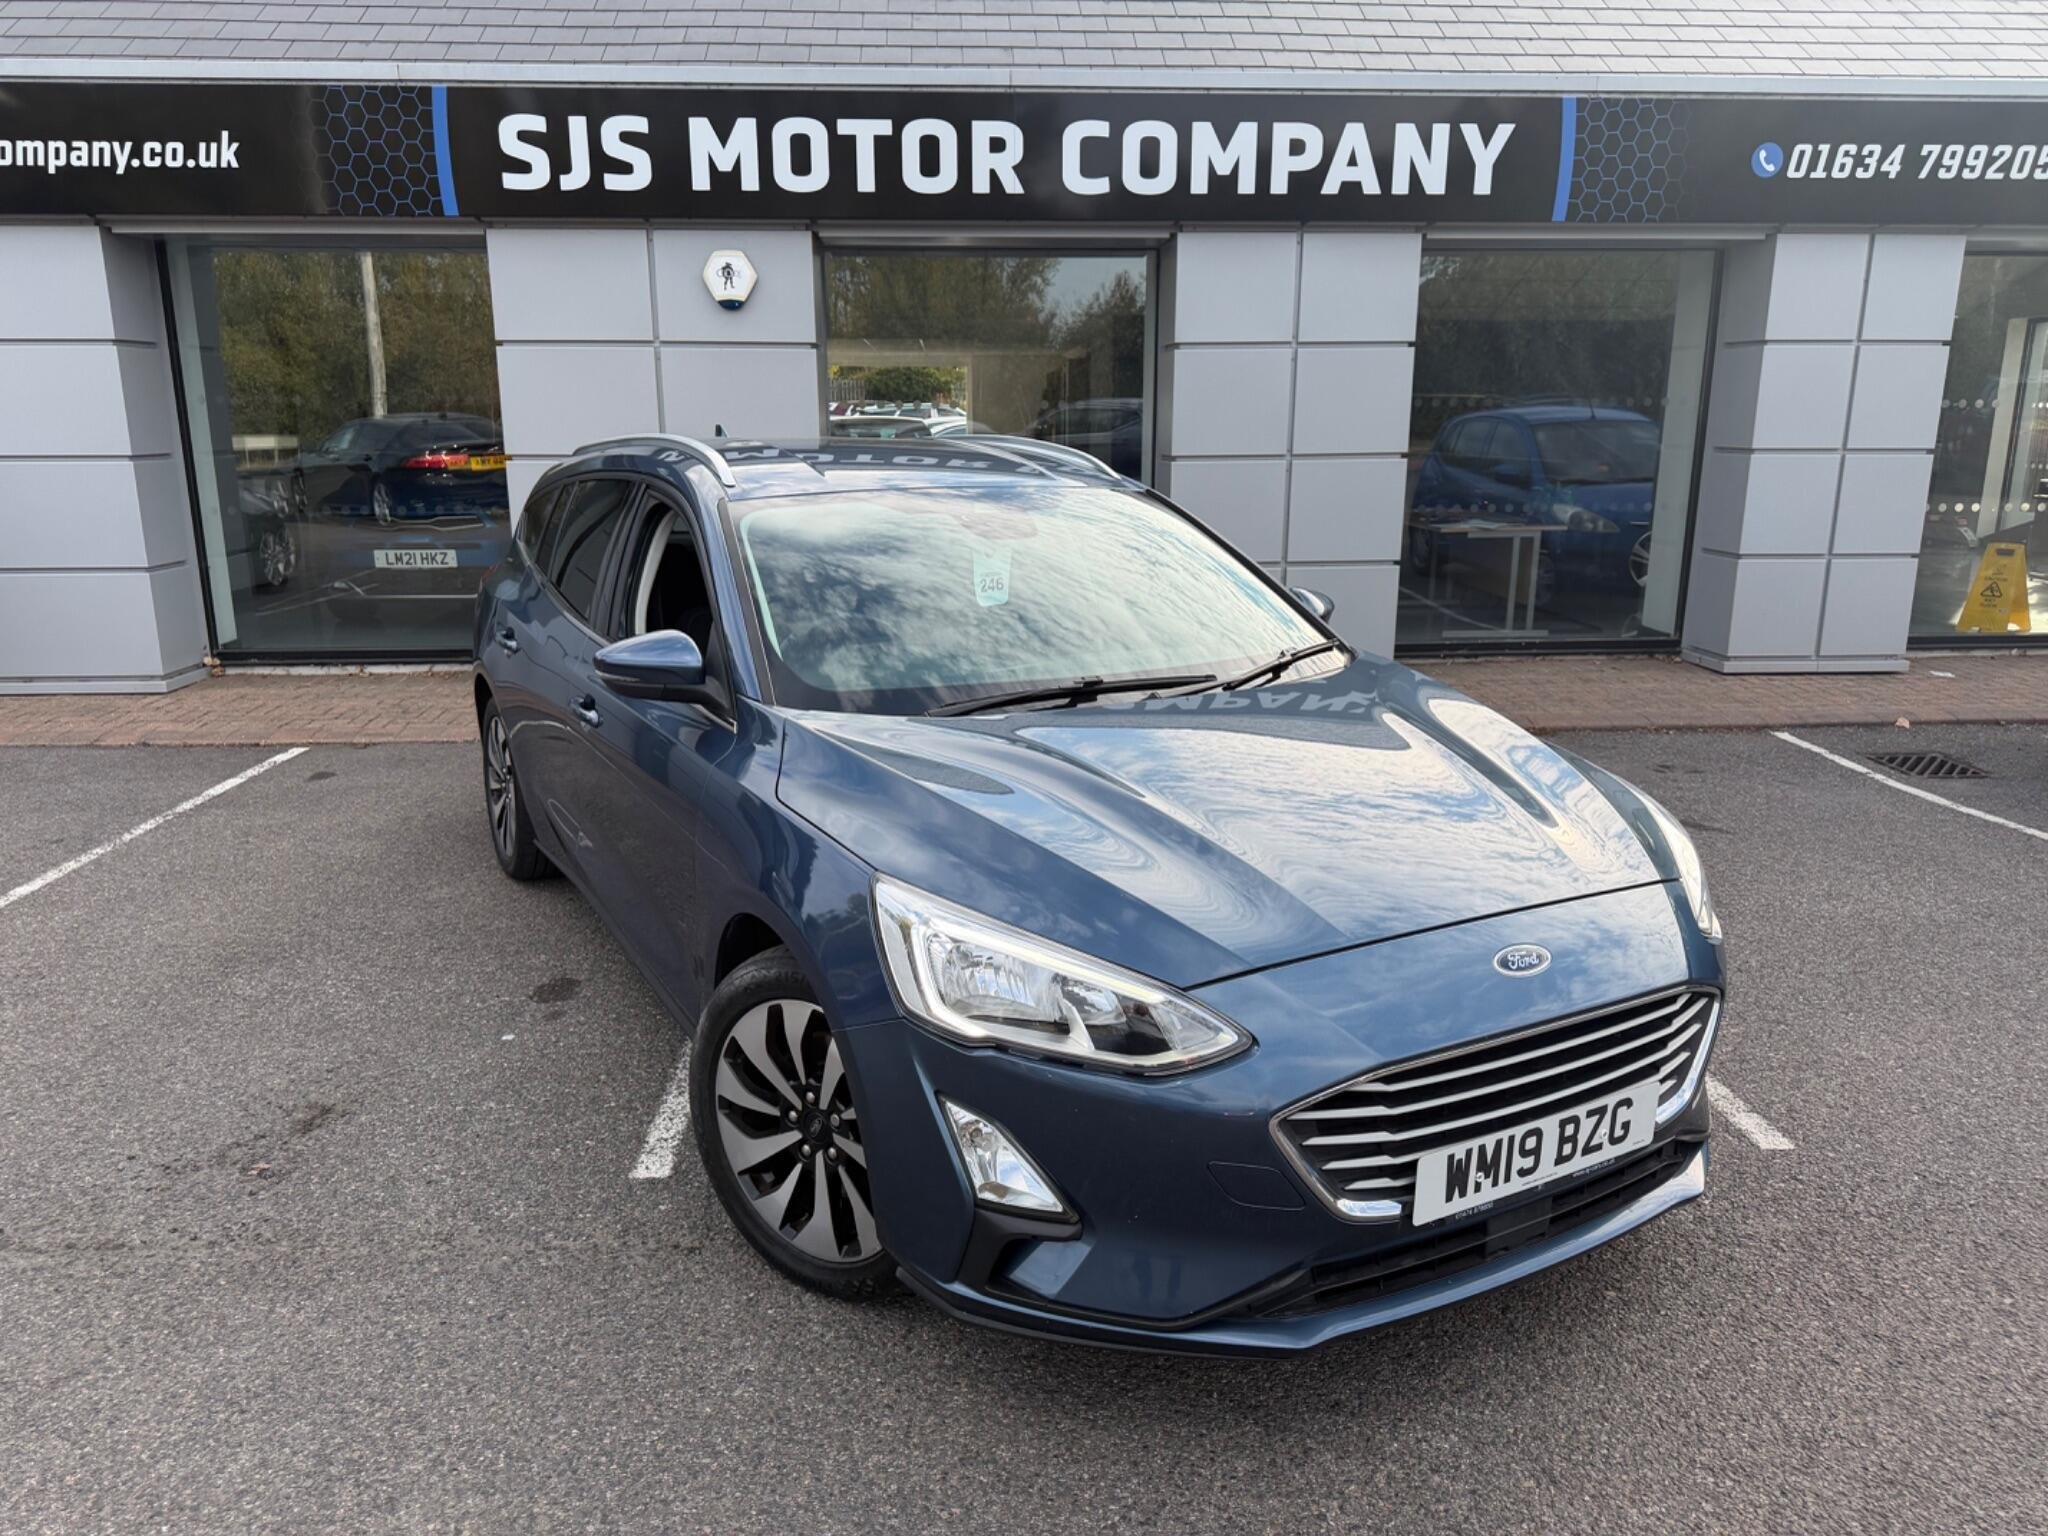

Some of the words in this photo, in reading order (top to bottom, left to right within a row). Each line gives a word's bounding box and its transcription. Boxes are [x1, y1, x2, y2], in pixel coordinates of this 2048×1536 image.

[0, 130, 240, 175] ompany.co.uk
[498, 113, 652, 192] SJS
[688, 116, 1025, 194] MOTOR
[1062, 119, 1516, 196] COMPANY
[1786, 143, 1906, 179] 01634
[419, 551, 450, 566] HKZ
[980, 577, 1004, 592] 246
[1508, 952, 1540, 970] Ford
[1445, 1127, 1544, 1204] WM19
[1554, 1097, 1634, 1167] BZG
